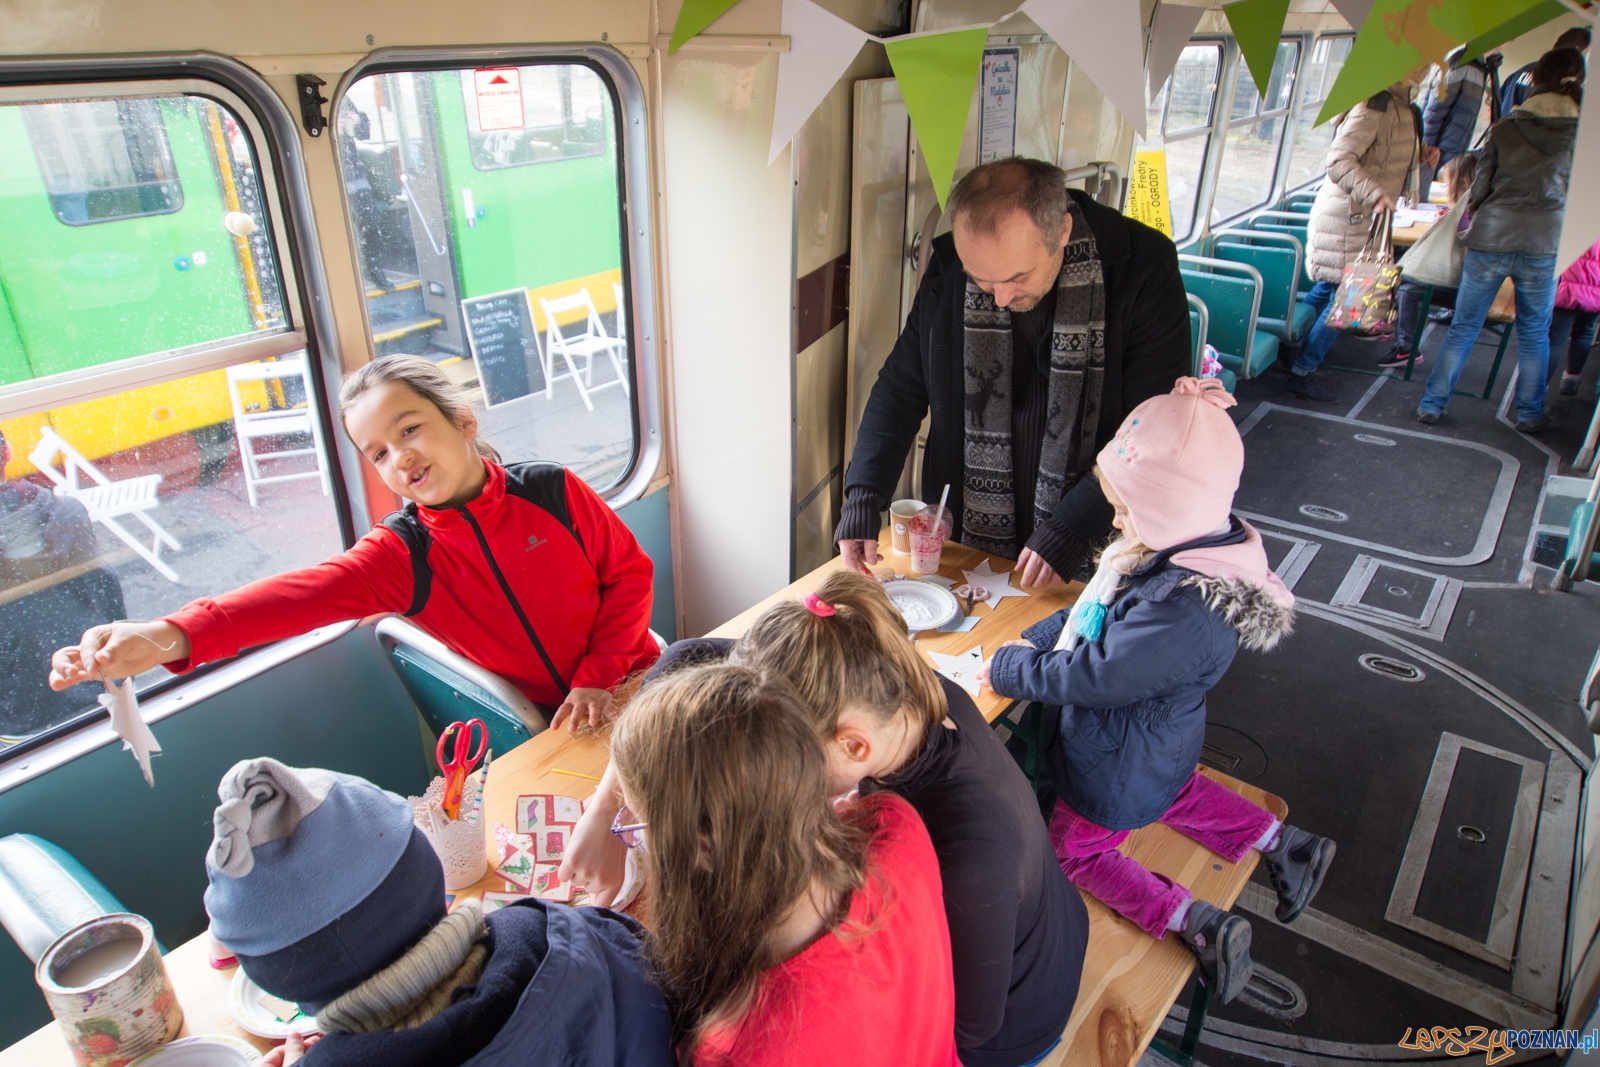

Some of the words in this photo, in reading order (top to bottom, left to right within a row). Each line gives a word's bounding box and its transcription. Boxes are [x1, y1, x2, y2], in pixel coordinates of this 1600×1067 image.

[1137, 161, 1147, 189] Fredry
[1148, 167, 1161, 207] OGRODY
[1155, 217, 1165, 232] ego
